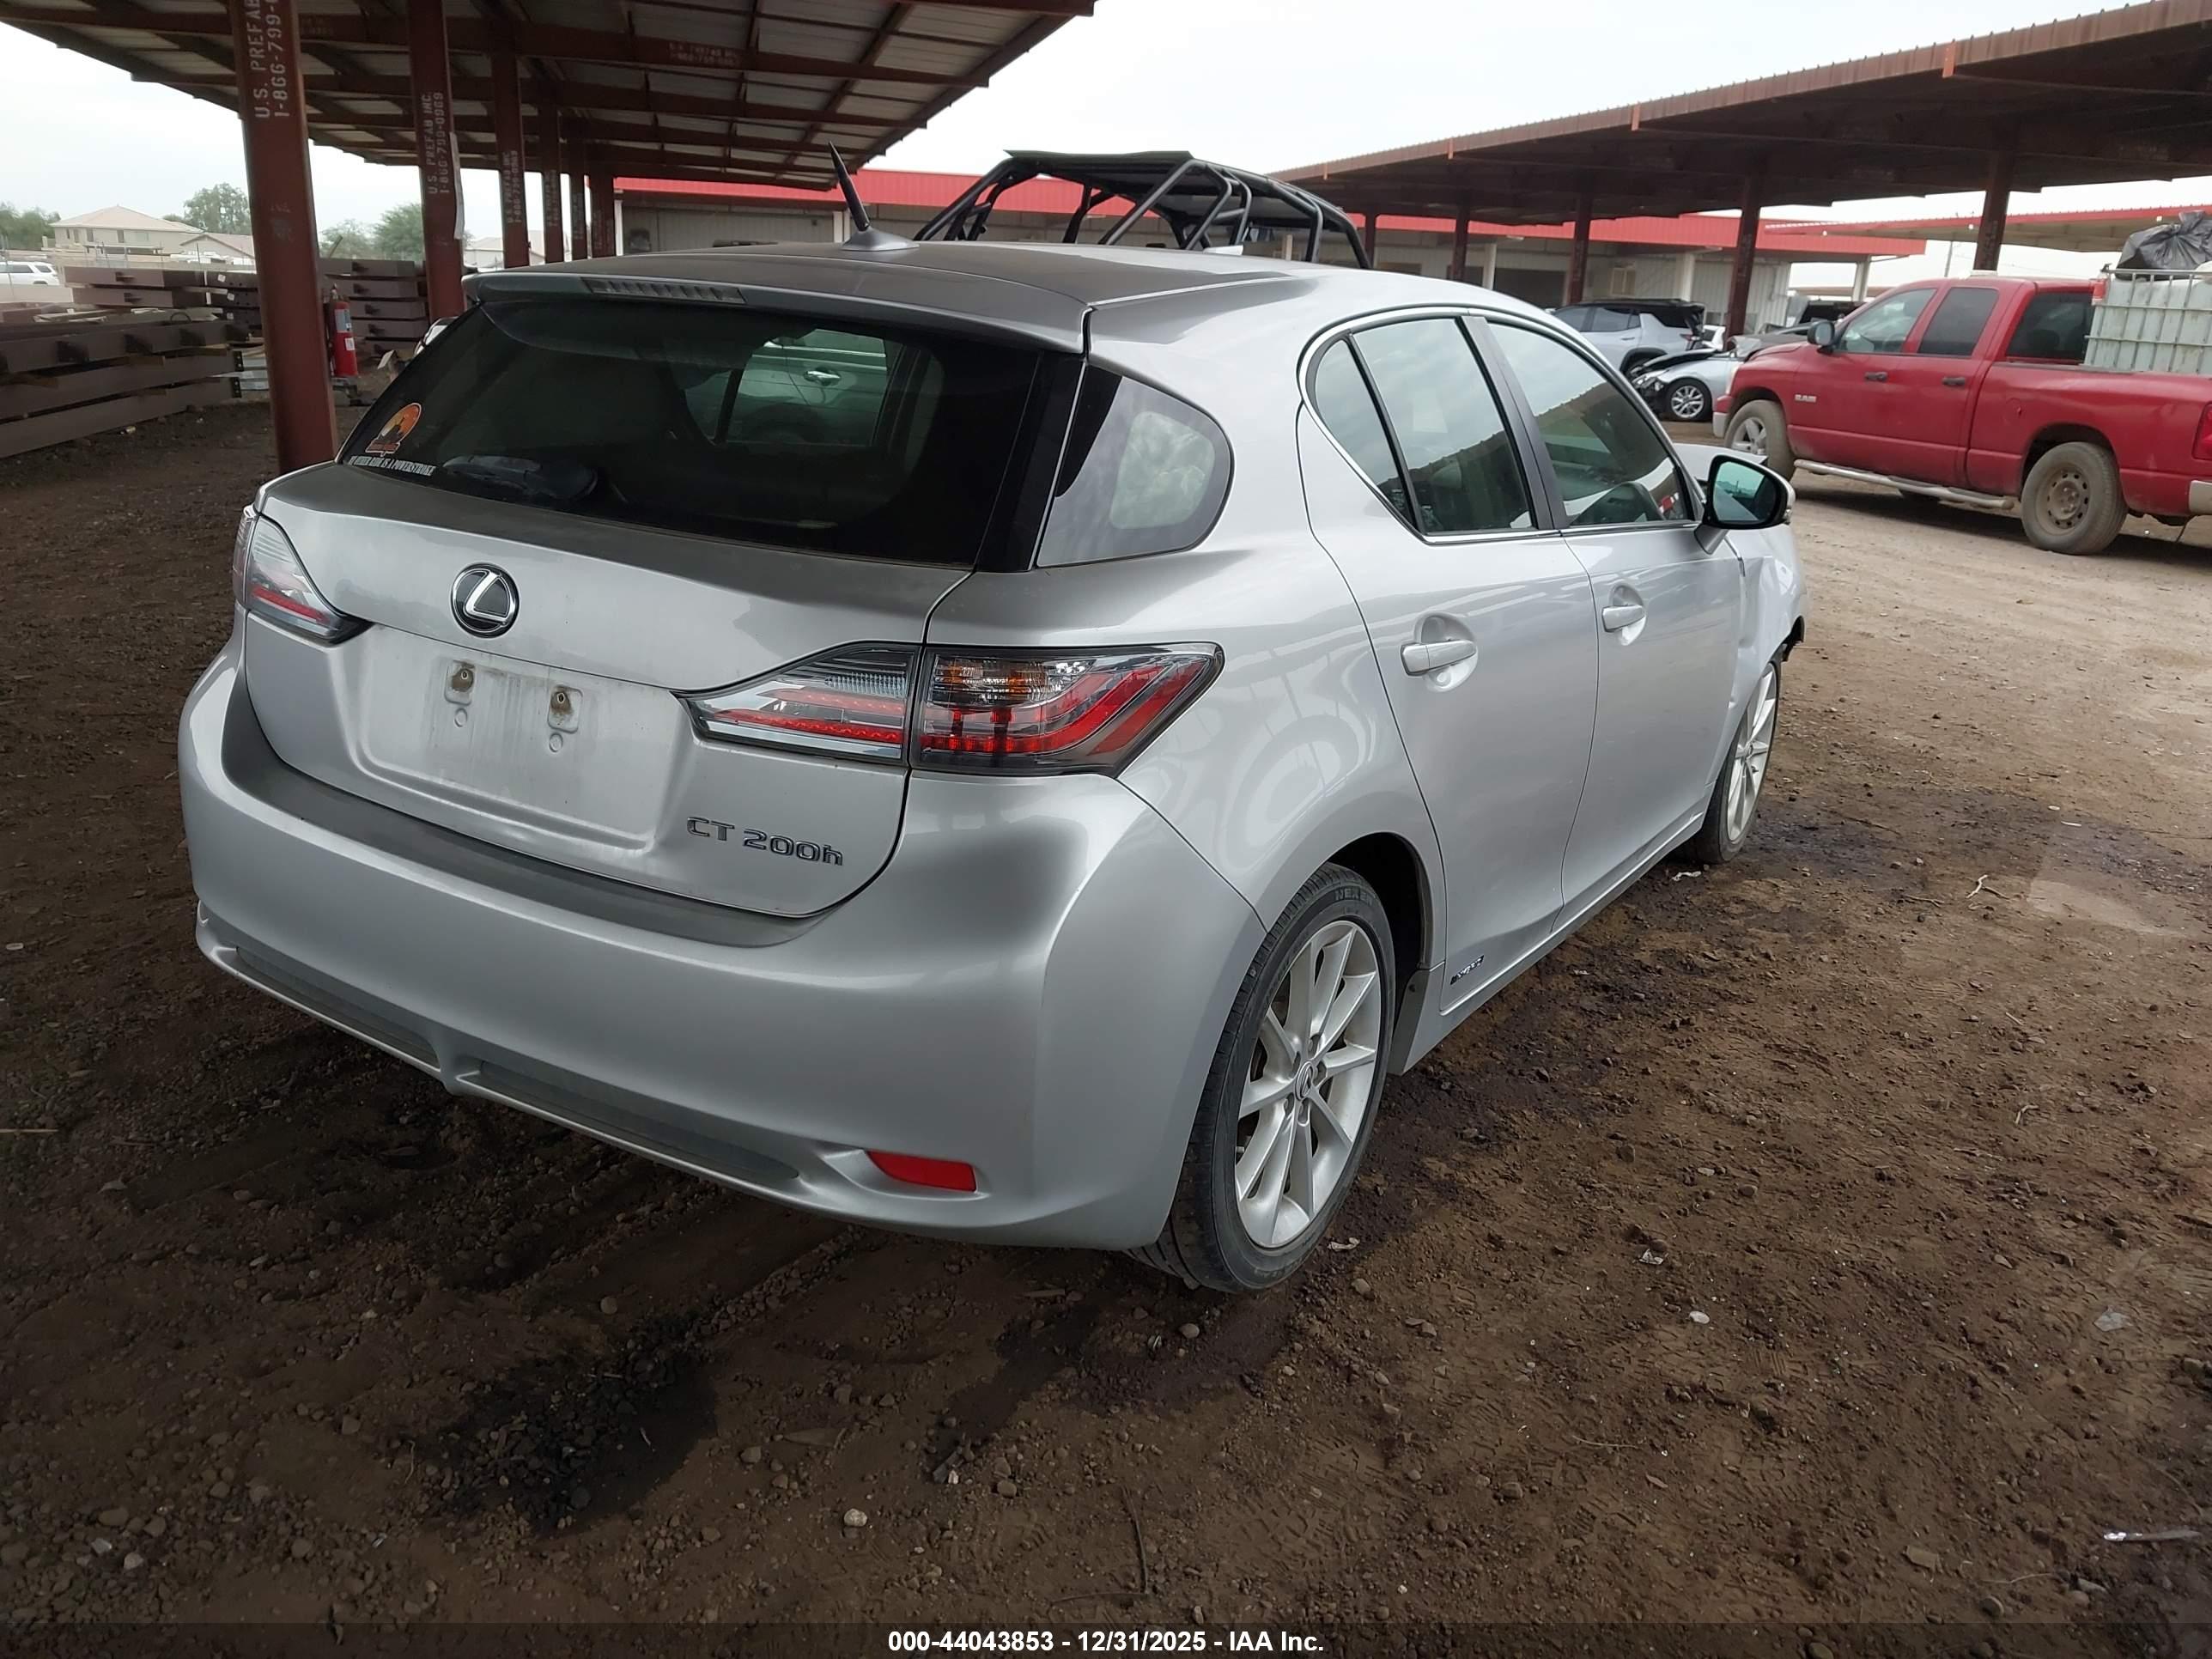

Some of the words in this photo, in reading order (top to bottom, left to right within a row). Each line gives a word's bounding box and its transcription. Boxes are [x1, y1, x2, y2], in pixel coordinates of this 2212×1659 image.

[244, 0, 267, 70] PREFAB
[253, 83, 270, 118] U.S.
[687, 817, 735, 842] CT
[743, 828, 843, 866] 200h
